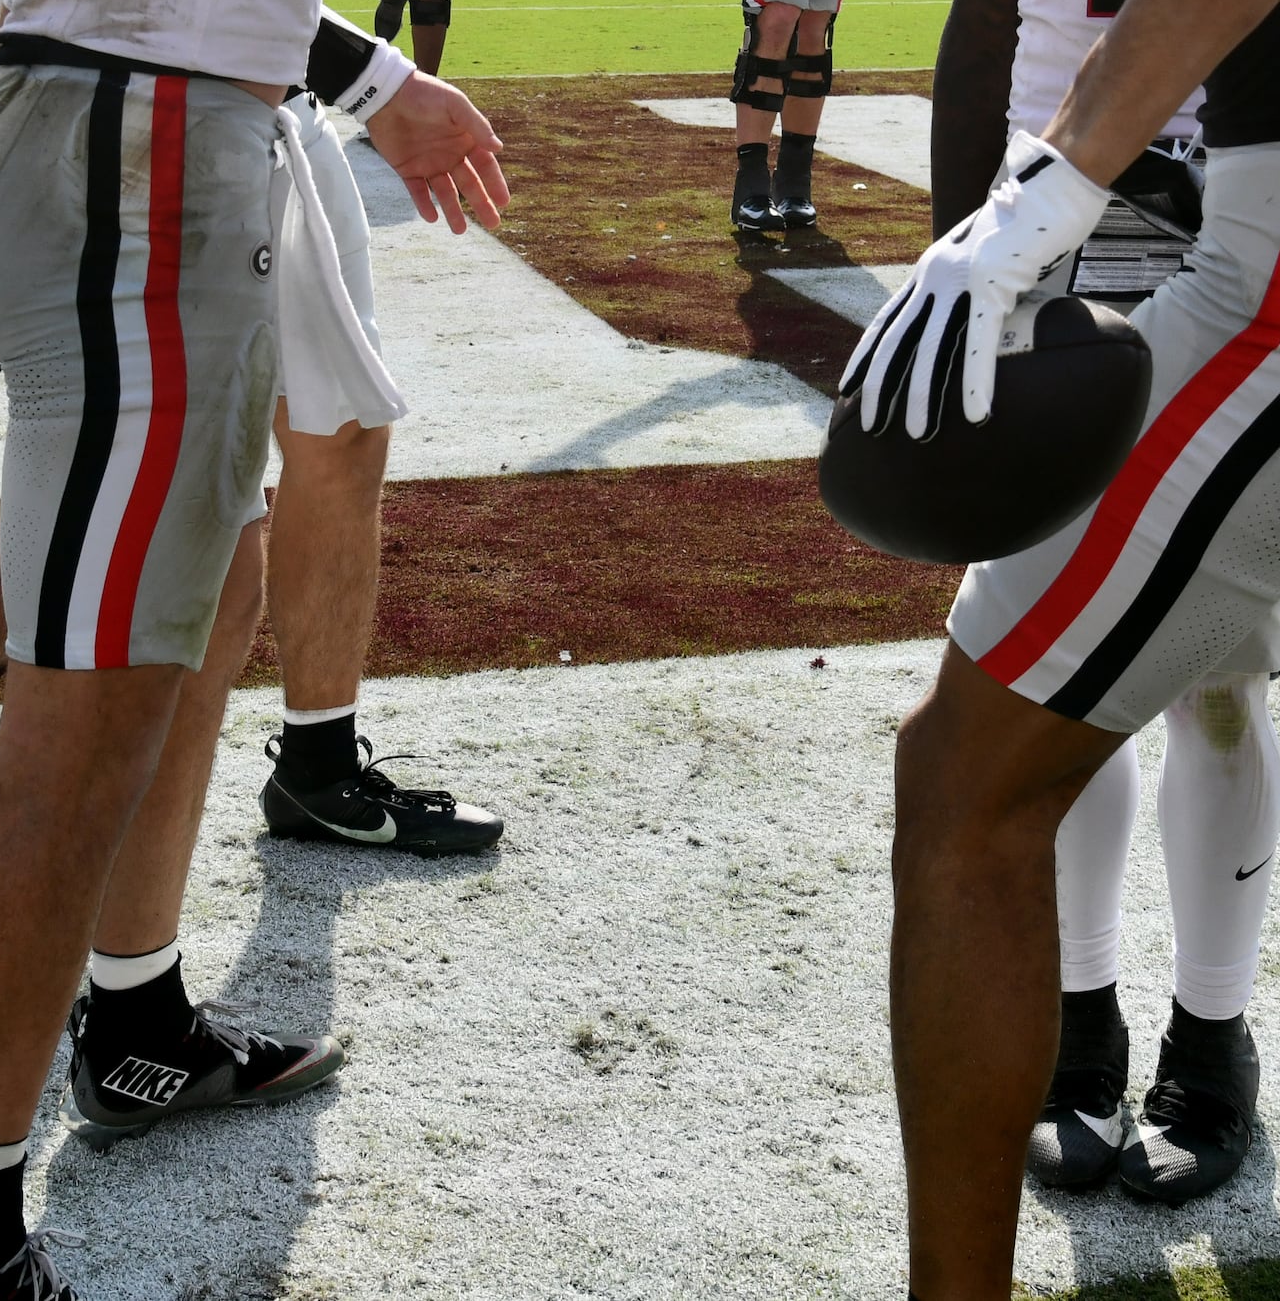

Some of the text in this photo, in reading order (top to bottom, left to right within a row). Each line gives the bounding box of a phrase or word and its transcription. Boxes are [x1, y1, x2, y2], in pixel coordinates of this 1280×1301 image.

[364, 86, 377, 98] GO
[249, 239, 273, 282] G
[106, 1057, 187, 1104] NIKE
